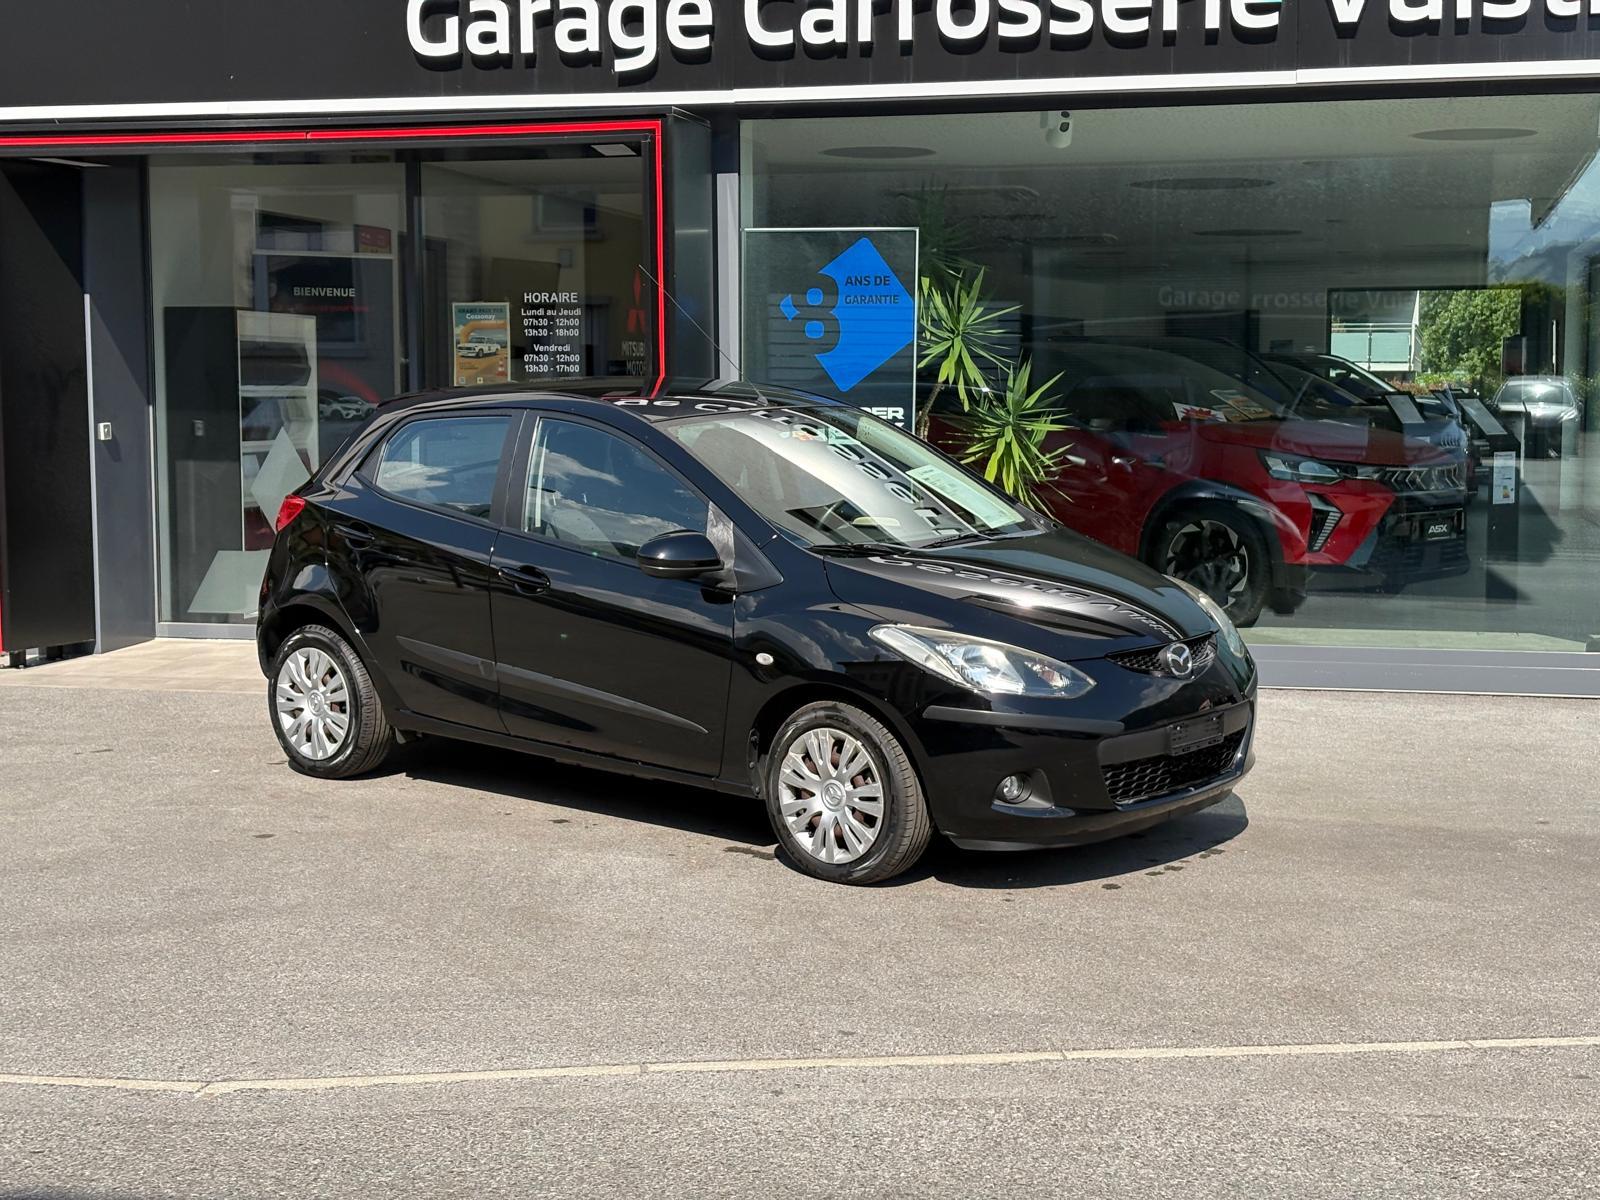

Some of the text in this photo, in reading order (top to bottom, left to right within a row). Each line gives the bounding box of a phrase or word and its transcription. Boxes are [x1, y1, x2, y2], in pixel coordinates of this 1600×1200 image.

[406, 0, 713, 72] Garage
[844, 276, 890, 286] ANS DE
[293, 286, 356, 297] BIENVENUE
[523, 292, 579, 303] HORAIRE
[844, 295, 899, 305] GARANTIE
[521, 307, 545, 316] Lundi
[558, 307, 582, 316] Jeudi
[523, 318, 548, 326] 07h30
[555, 318, 580, 326] 12h00
[524, 328, 548, 337] 13h30
[555, 328, 579, 337] 18h00
[533, 343, 571, 352] Vendredi
[523, 354, 549, 362] 07h30
[556, 354, 580, 362] 12h00
[525, 364, 549, 373] 13h30
[556, 364, 580, 373] 17h00
[1428, 524, 1448, 534] ASX
